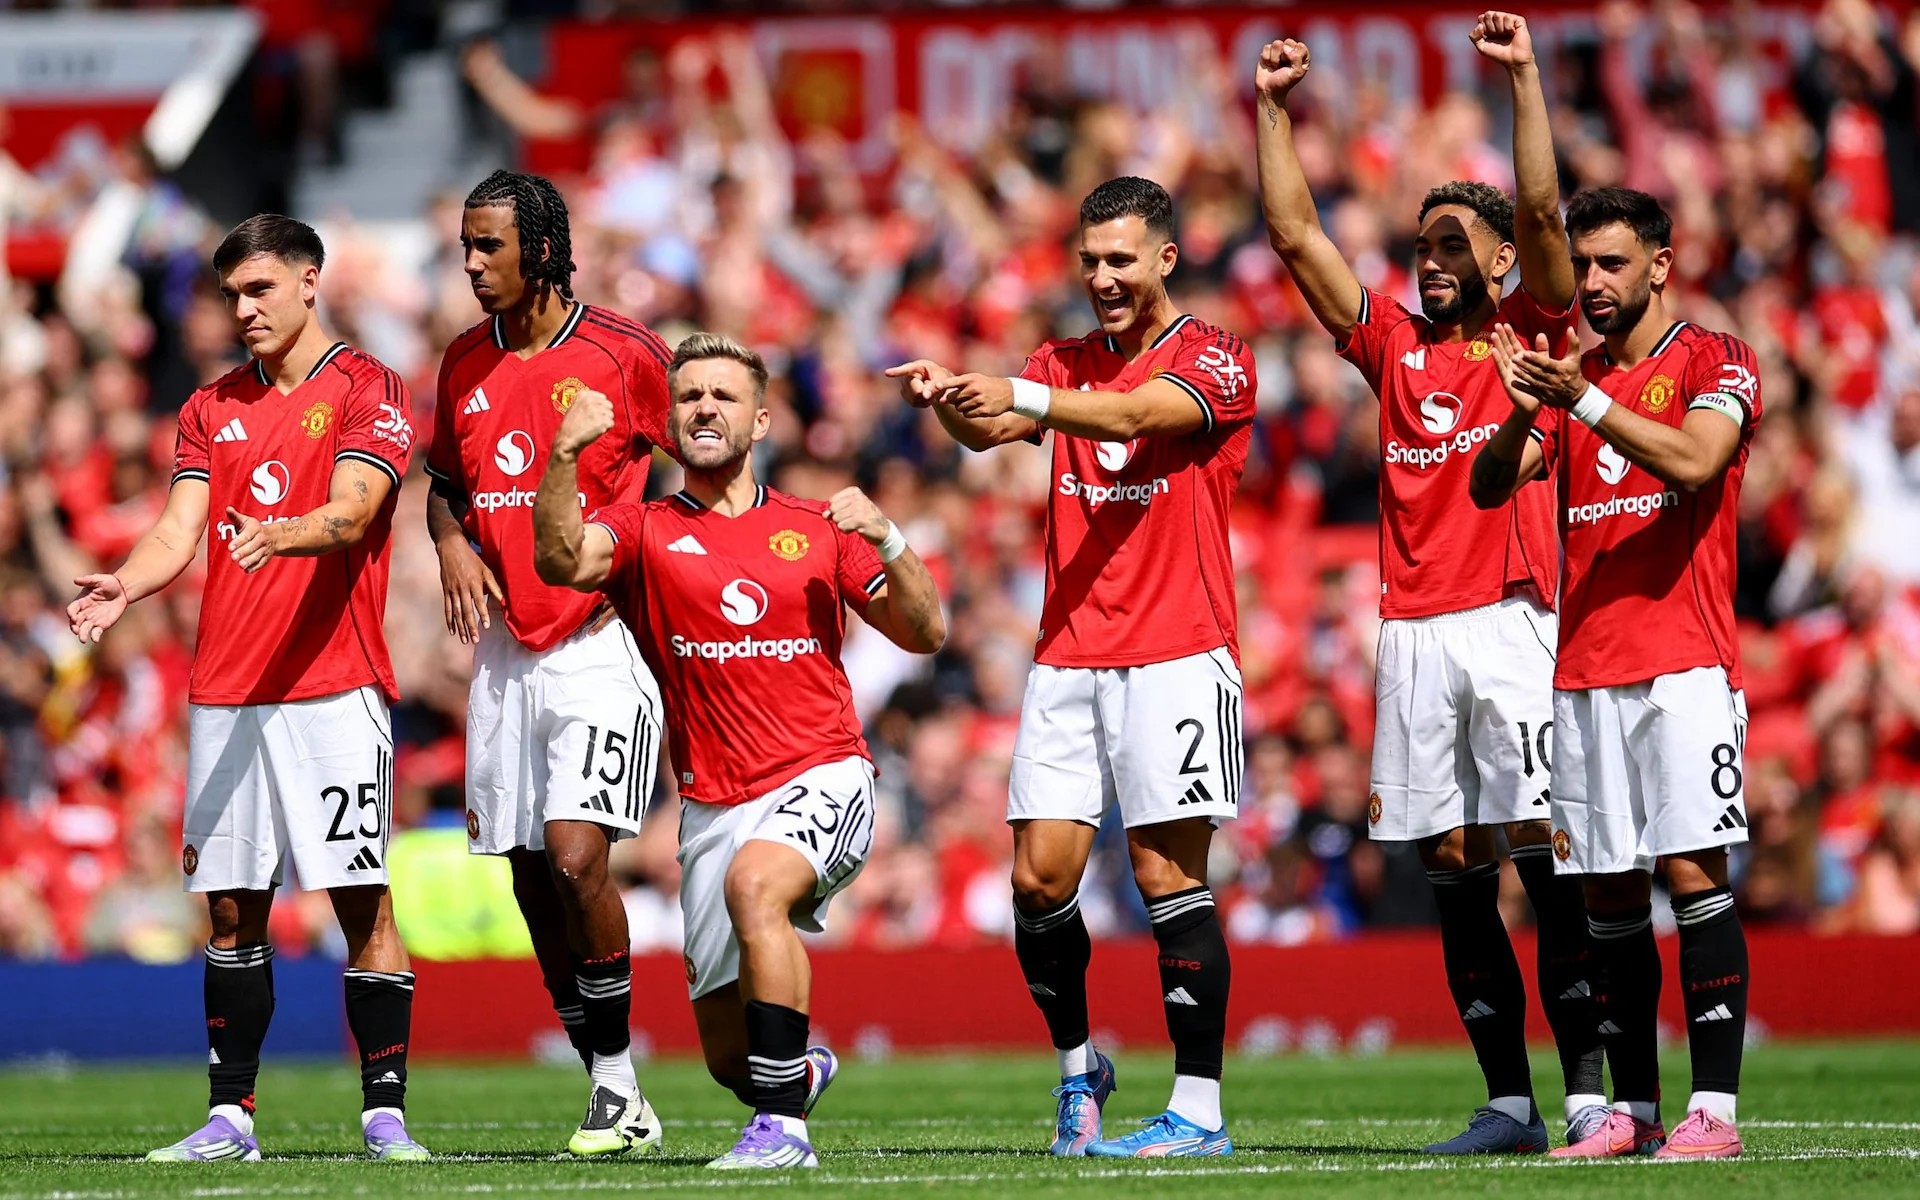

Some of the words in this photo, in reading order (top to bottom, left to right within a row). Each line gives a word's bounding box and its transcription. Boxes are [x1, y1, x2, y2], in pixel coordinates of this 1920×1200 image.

[1567, 490, 1678, 525] napdragon
[670, 634, 822, 664] Snapdragon
[582, 725, 628, 785] 15
[1175, 718, 1210, 775] 2
[1711, 743, 1742, 799] 8
[320, 783, 381, 843] 25
[775, 785, 844, 835] 23
